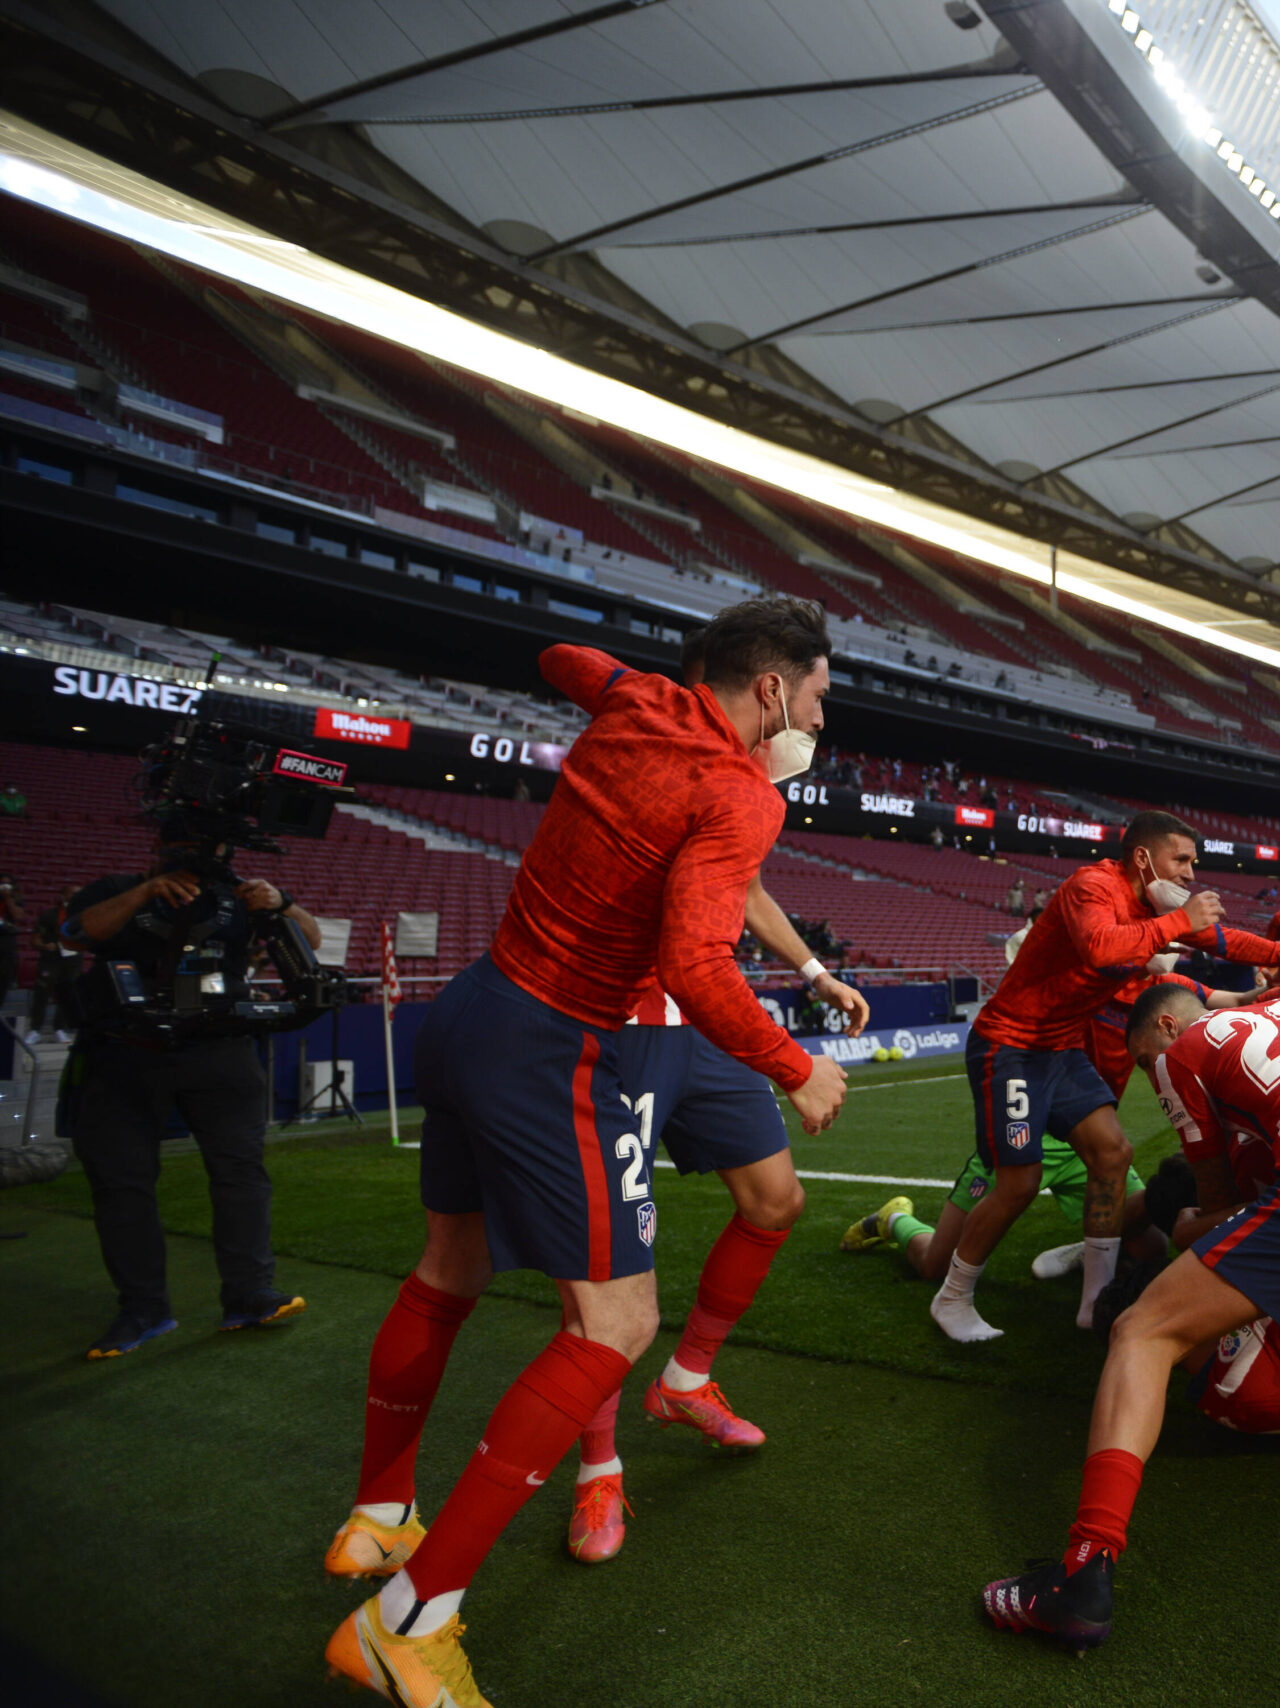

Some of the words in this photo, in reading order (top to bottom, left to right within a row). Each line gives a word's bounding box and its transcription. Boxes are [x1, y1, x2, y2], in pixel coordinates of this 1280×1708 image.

[331, 713, 391, 736] Mahou
[470, 733, 535, 765] GOL
[280, 756, 344, 782] #FANCAM
[787, 782, 829, 805] GOL
[1017, 814, 1047, 834] GOL
[820, 1035, 881, 1062] MARCA
[916, 1031, 960, 1048] LaLiga
[1006, 1079, 1030, 1120] 5
[615, 1133, 649, 1201] 2
